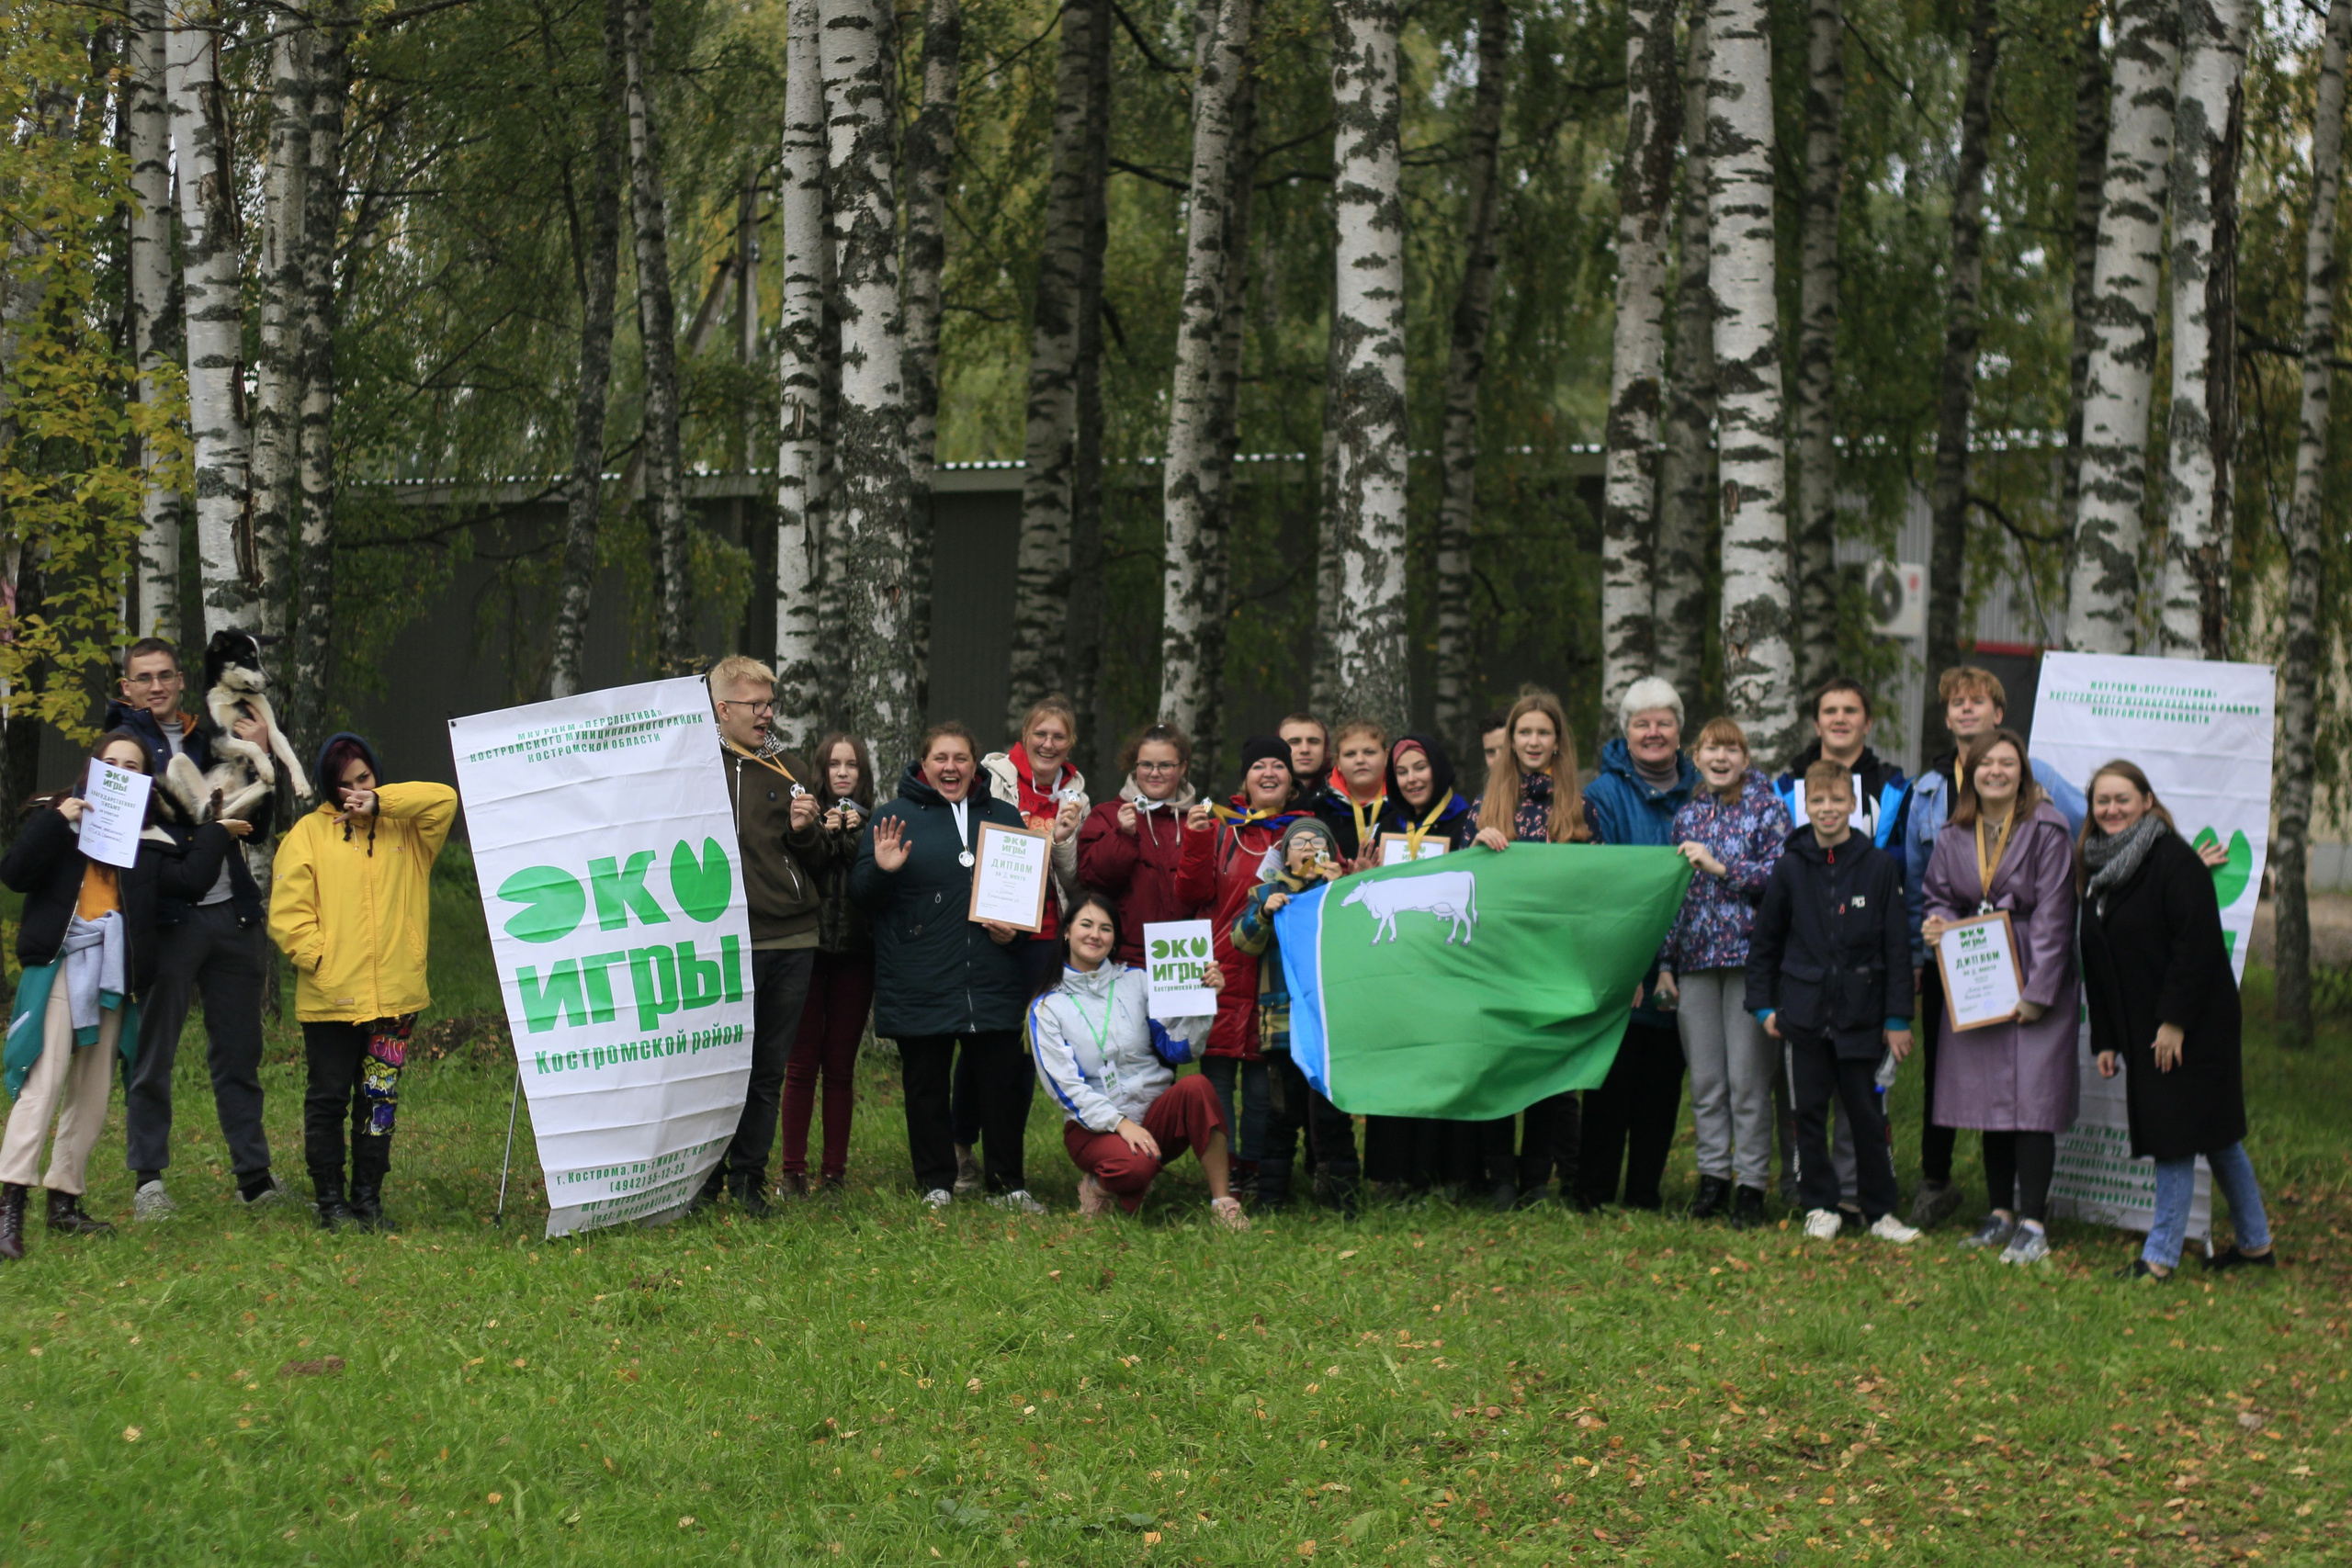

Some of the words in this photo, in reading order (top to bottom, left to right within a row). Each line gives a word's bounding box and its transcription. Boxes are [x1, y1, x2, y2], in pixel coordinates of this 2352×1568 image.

[517, 729, 540, 741] МКУ
[544, 723, 575, 736] РЦКМ
[579, 708, 662, 729] «ПЕРСПЕКТИВА»
[2164, 711, 2210, 725] ОБЛАСТИ
[469, 734, 562, 762] КОСТРОМСКОГО
[565, 719, 664, 742] МУНИЦИПАЛЬНОГО
[666, 713, 704, 728] РАЙОНА
[527, 739, 608, 763] КОСТРОМСКОЙ
[611, 732, 661, 750] ОБЛАСТИ
[991, 858, 1033, 874] ДИПЛОМ
[497, 836, 732, 943] ЭКО
[1150, 936, 1209, 960] ЭКО
[1154, 984, 1193, 993] Костромской
[535, 1028, 687, 1075] Костромской
[691, 1022, 744, 1055] район
[556, 1176, 566, 1186] г.
[568, 1166, 630, 1184] Кострома,
